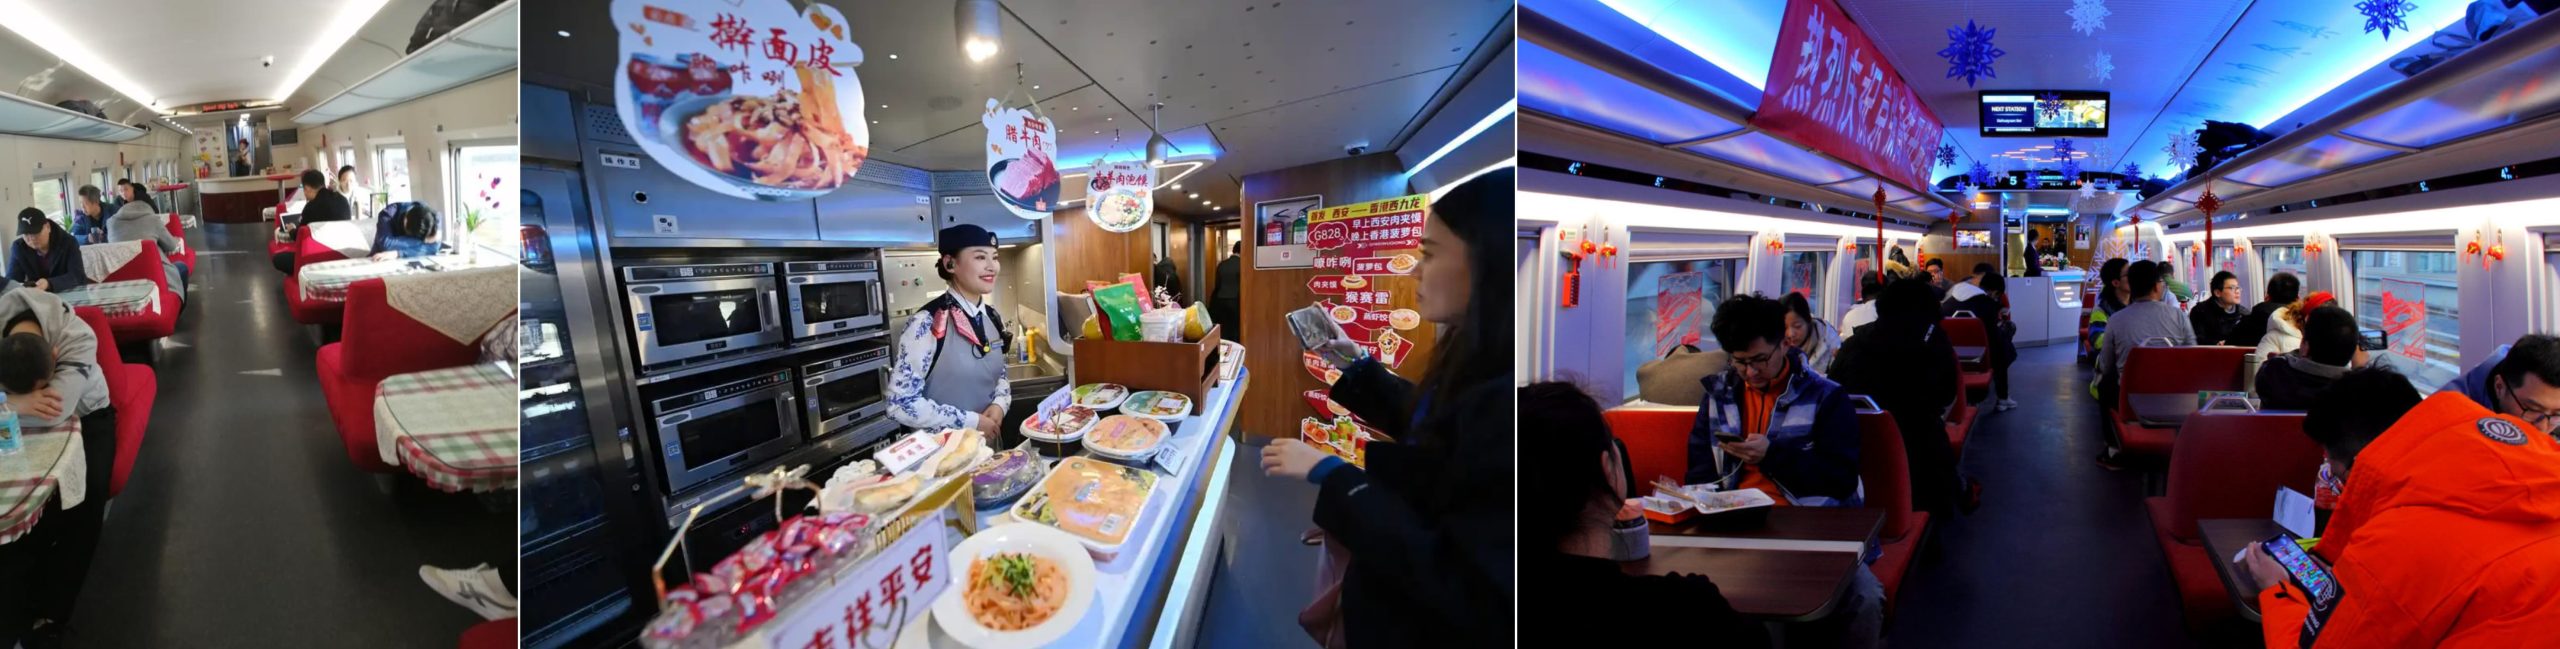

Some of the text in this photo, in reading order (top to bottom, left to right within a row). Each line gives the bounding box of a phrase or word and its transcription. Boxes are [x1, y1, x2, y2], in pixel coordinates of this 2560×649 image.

[709, 13, 842, 77] 擀面皮
[1005, 124, 1042, 151] 腊牛肉
[2009, 176, 2017, 185] 5
[1353, 212, 1422, 228] 早上西安肉夹馍
[1351, 226, 1422, 242] 晚上香港菠萝包
[1356, 263, 1383, 271] 菠萝包
[1313, 280, 1338, 289] 肉夹馍
[1345, 291, 1389, 304] 猴赛雷
